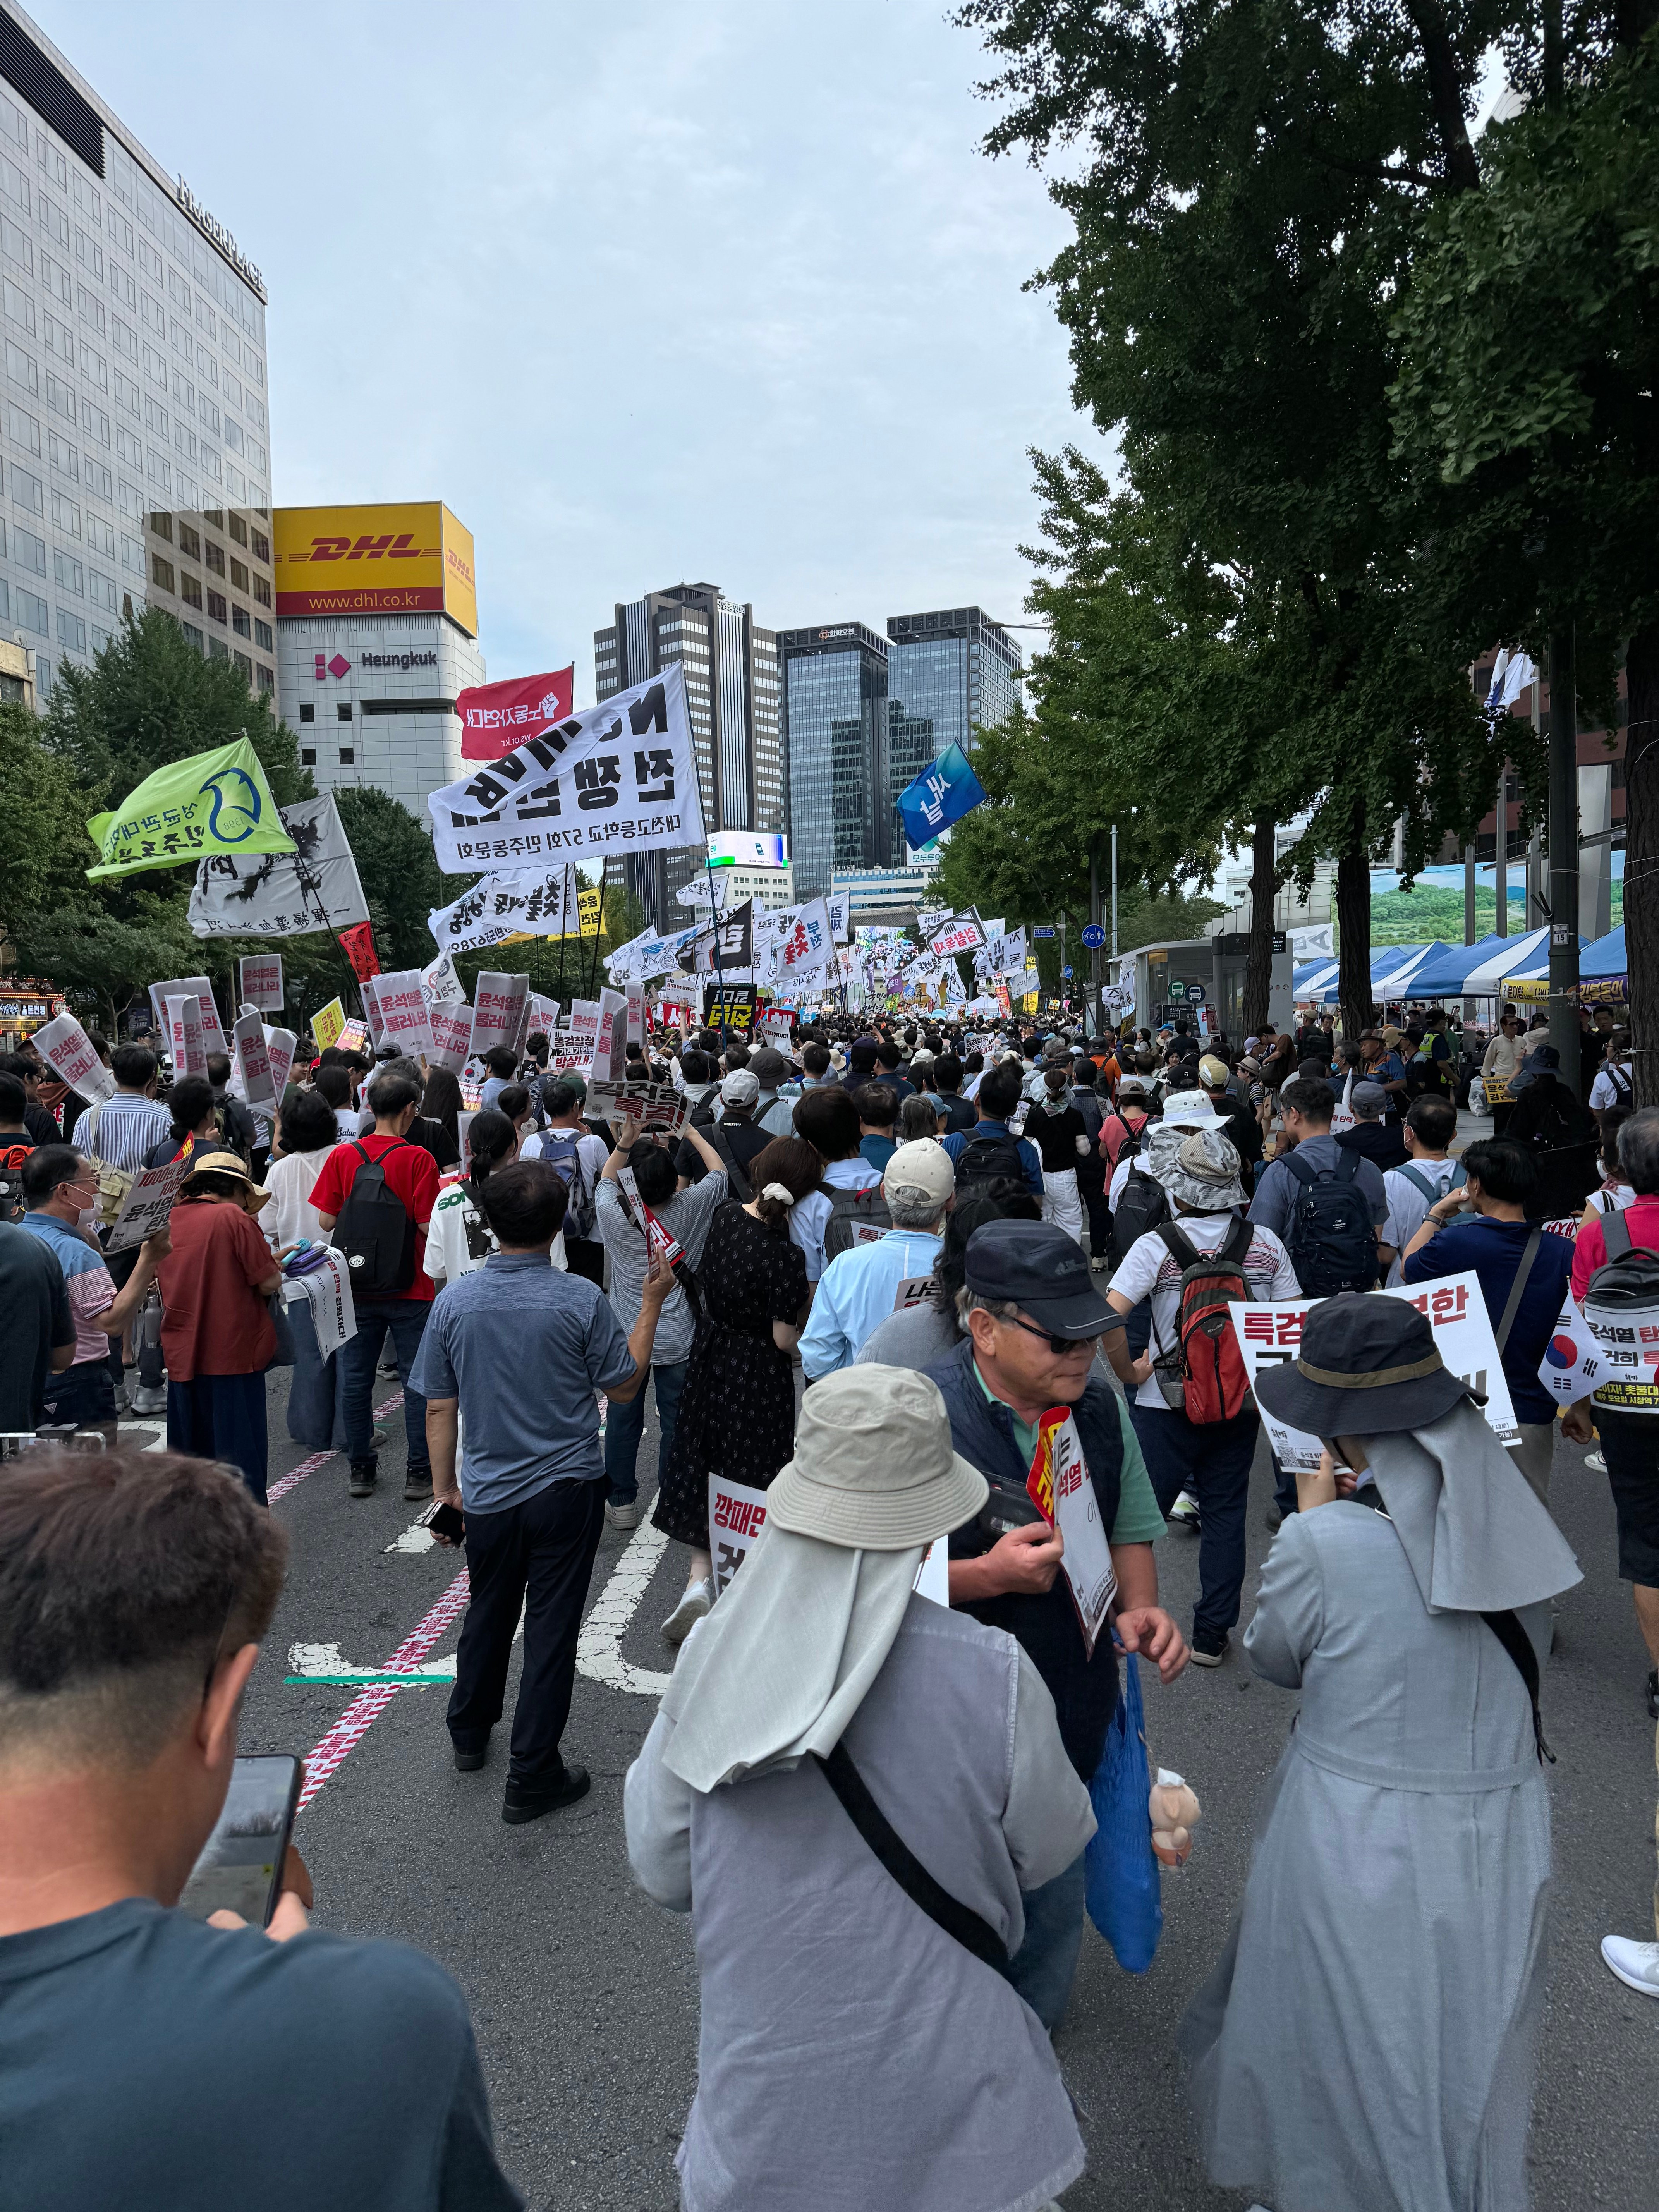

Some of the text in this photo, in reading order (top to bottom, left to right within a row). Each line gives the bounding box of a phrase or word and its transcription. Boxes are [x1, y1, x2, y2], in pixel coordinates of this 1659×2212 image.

[309, 534, 422, 561] DHL
[448, 548, 472, 583] DHL
[309, 592, 421, 608] www.dhl.co.kr
[362, 650, 437, 669] Heungkuk
[243, 967, 279, 981] 윤석열은
[244, 981, 280, 995] 물러나라
[380, 989, 424, 1013] 윤석열은
[478, 992, 524, 1011] 윤석열은
[385, 1009, 428, 1032] 물러나라
[430, 1013, 472, 1038] 윤석열은
[573, 1014, 598, 1029] 윤석열
[708, 1004, 752, 1028] 천년
[48, 1028, 88, 1067] 윤석열은
[63, 1046, 99, 1085] 물러나라
[593, 1081, 688, 1113] 김건희
[137, 1167, 176, 1188] 1000만
[1244, 1312, 1308, 1346] 특검
[1602, 1349, 1638, 1367] 건희
[1597, 1383, 1659, 1396] 이자! 촛불대
[1608, 1394, 1628, 1404] 토요일
[1630, 1396, 1652, 1405] 시청역
[418, 1616, 443, 1635] 안전제일
[398, 1640, 424, 1662] DANGER!
[344, 1702, 375, 1726] 안전제일
[316, 1732, 351, 1760] DANGER!
